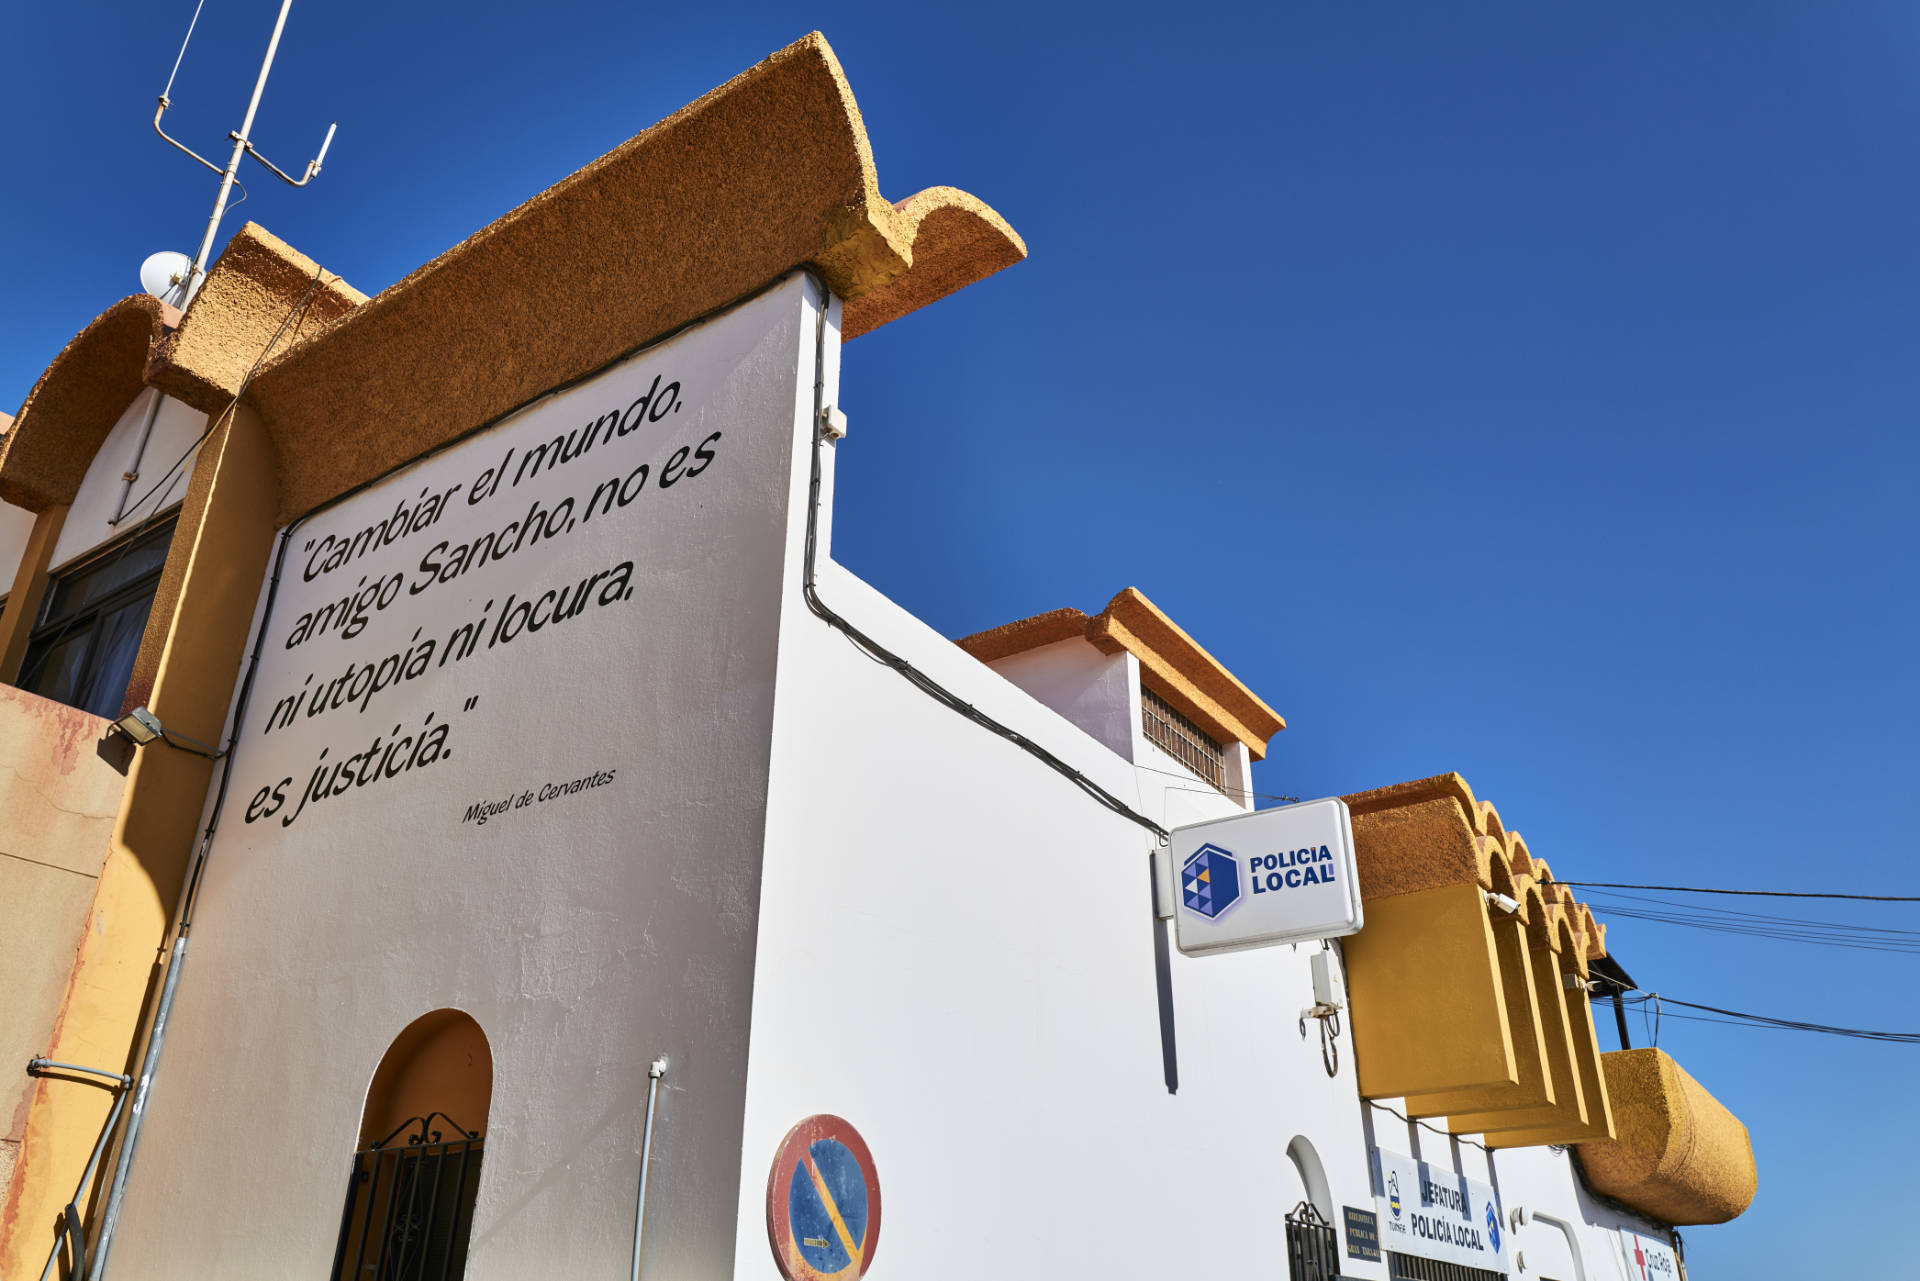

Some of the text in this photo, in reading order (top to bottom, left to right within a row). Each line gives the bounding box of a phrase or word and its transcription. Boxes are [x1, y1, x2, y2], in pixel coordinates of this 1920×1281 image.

[304, 374, 682, 583] "Cambiar el mundo,
[285, 431, 722, 650] amigo Sancho, no es
[263, 560, 634, 735] ni utopía ni locura,
[244, 776, 293, 825] es
[462, 769, 617, 826] Miguel de Cervantes
[1252, 864, 1335, 894] LOCAL
[1421, 1180, 1468, 1213] JEFATURA
[1411, 1213, 1484, 1251] POLICÍA LOCAL
